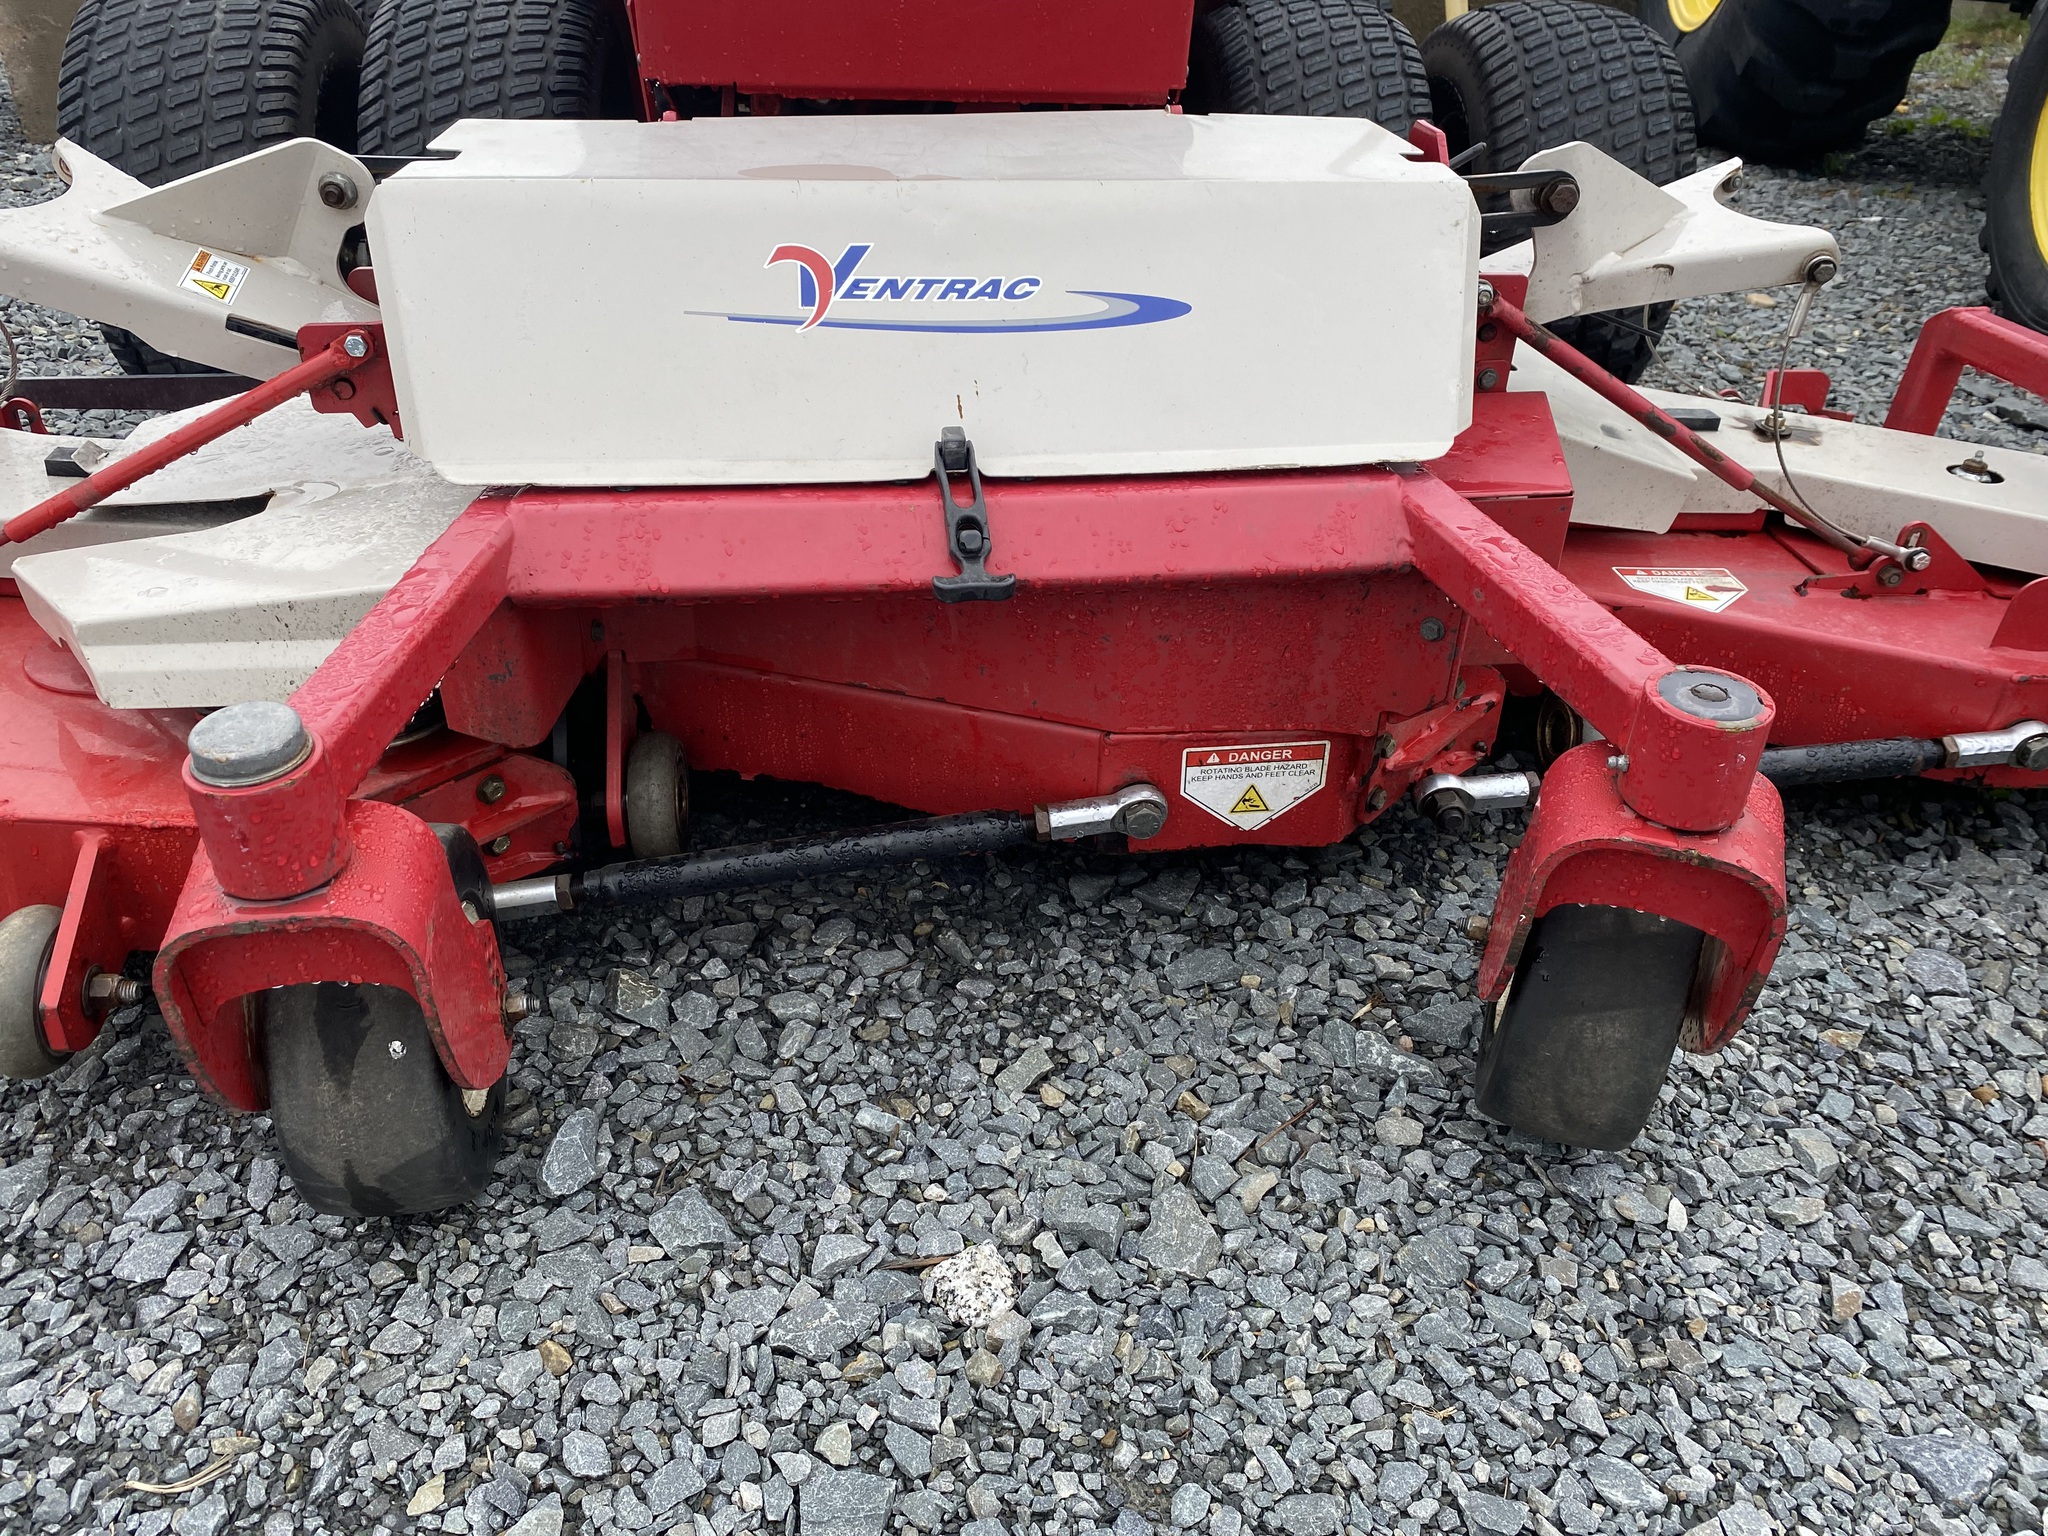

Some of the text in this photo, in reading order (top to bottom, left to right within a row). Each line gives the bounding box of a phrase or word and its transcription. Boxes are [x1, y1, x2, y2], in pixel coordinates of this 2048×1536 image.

[763, 242, 1043, 333] VENTRAC
[1228, 750, 1293, 763] DANGER
[1200, 766, 1243, 775] ROTATING
[1273, 763, 1308, 771] HAZARD
[1215, 773, 1244, 781] HANDS
[1288, 769, 1316, 777] CLEAR
